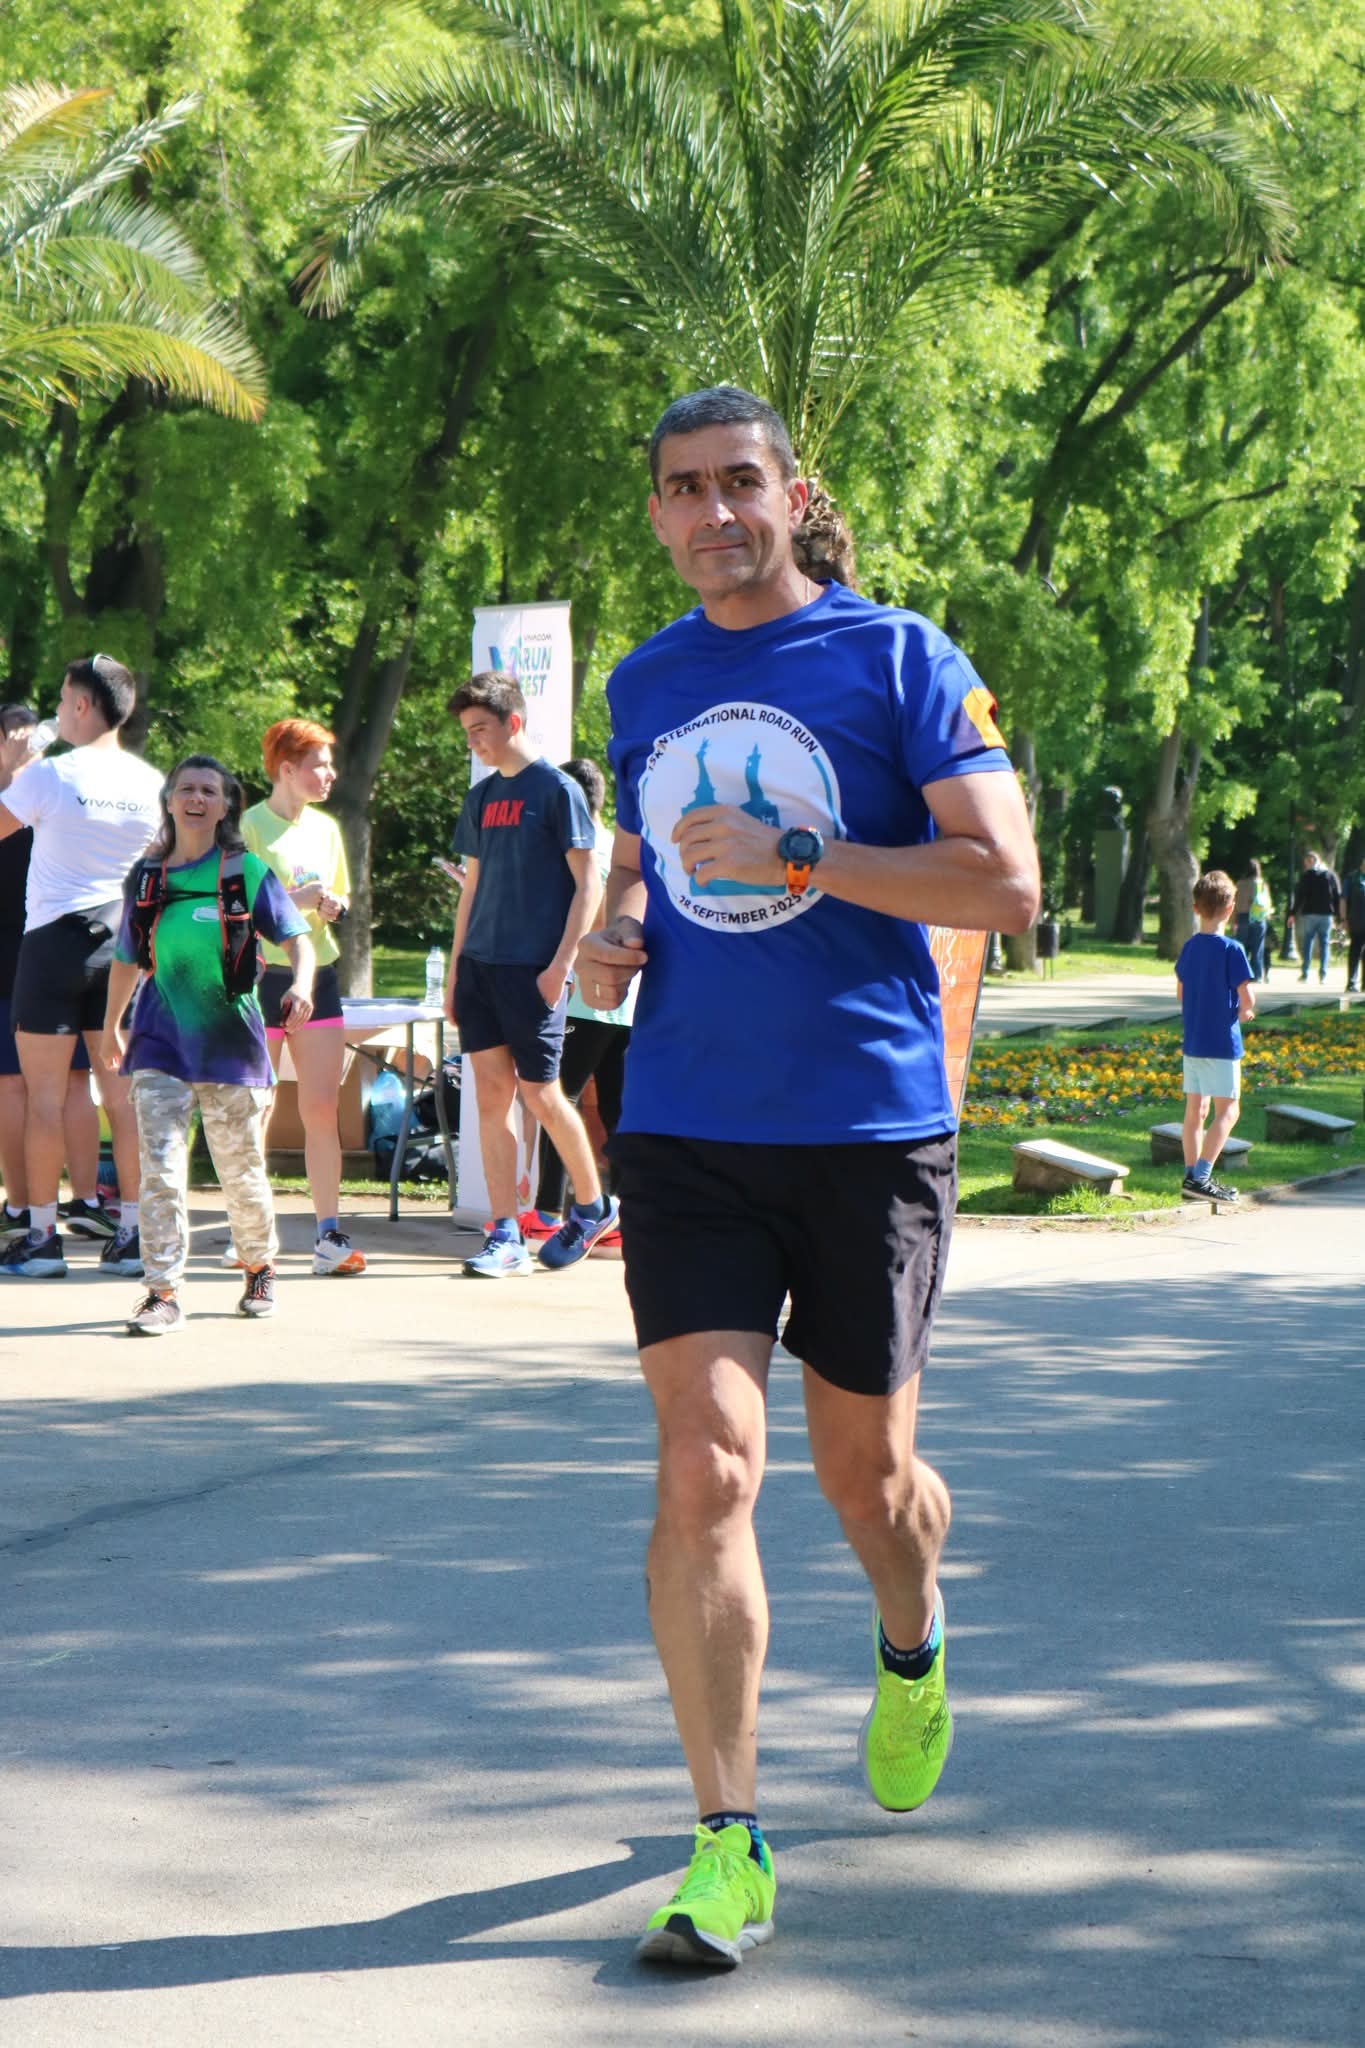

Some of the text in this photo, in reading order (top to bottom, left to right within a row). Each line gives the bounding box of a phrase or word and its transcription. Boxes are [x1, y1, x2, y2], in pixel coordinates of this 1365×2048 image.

[523, 646, 552, 671] RUN
[519, 674, 547, 697] FEST
[759, 710, 792, 730] ROAD
[790, 725, 818, 753] RUN
[481, 799, 525, 829] MAX
[692, 904, 768, 924] SEPTEMBER
[769, 893, 802, 916] 2025
